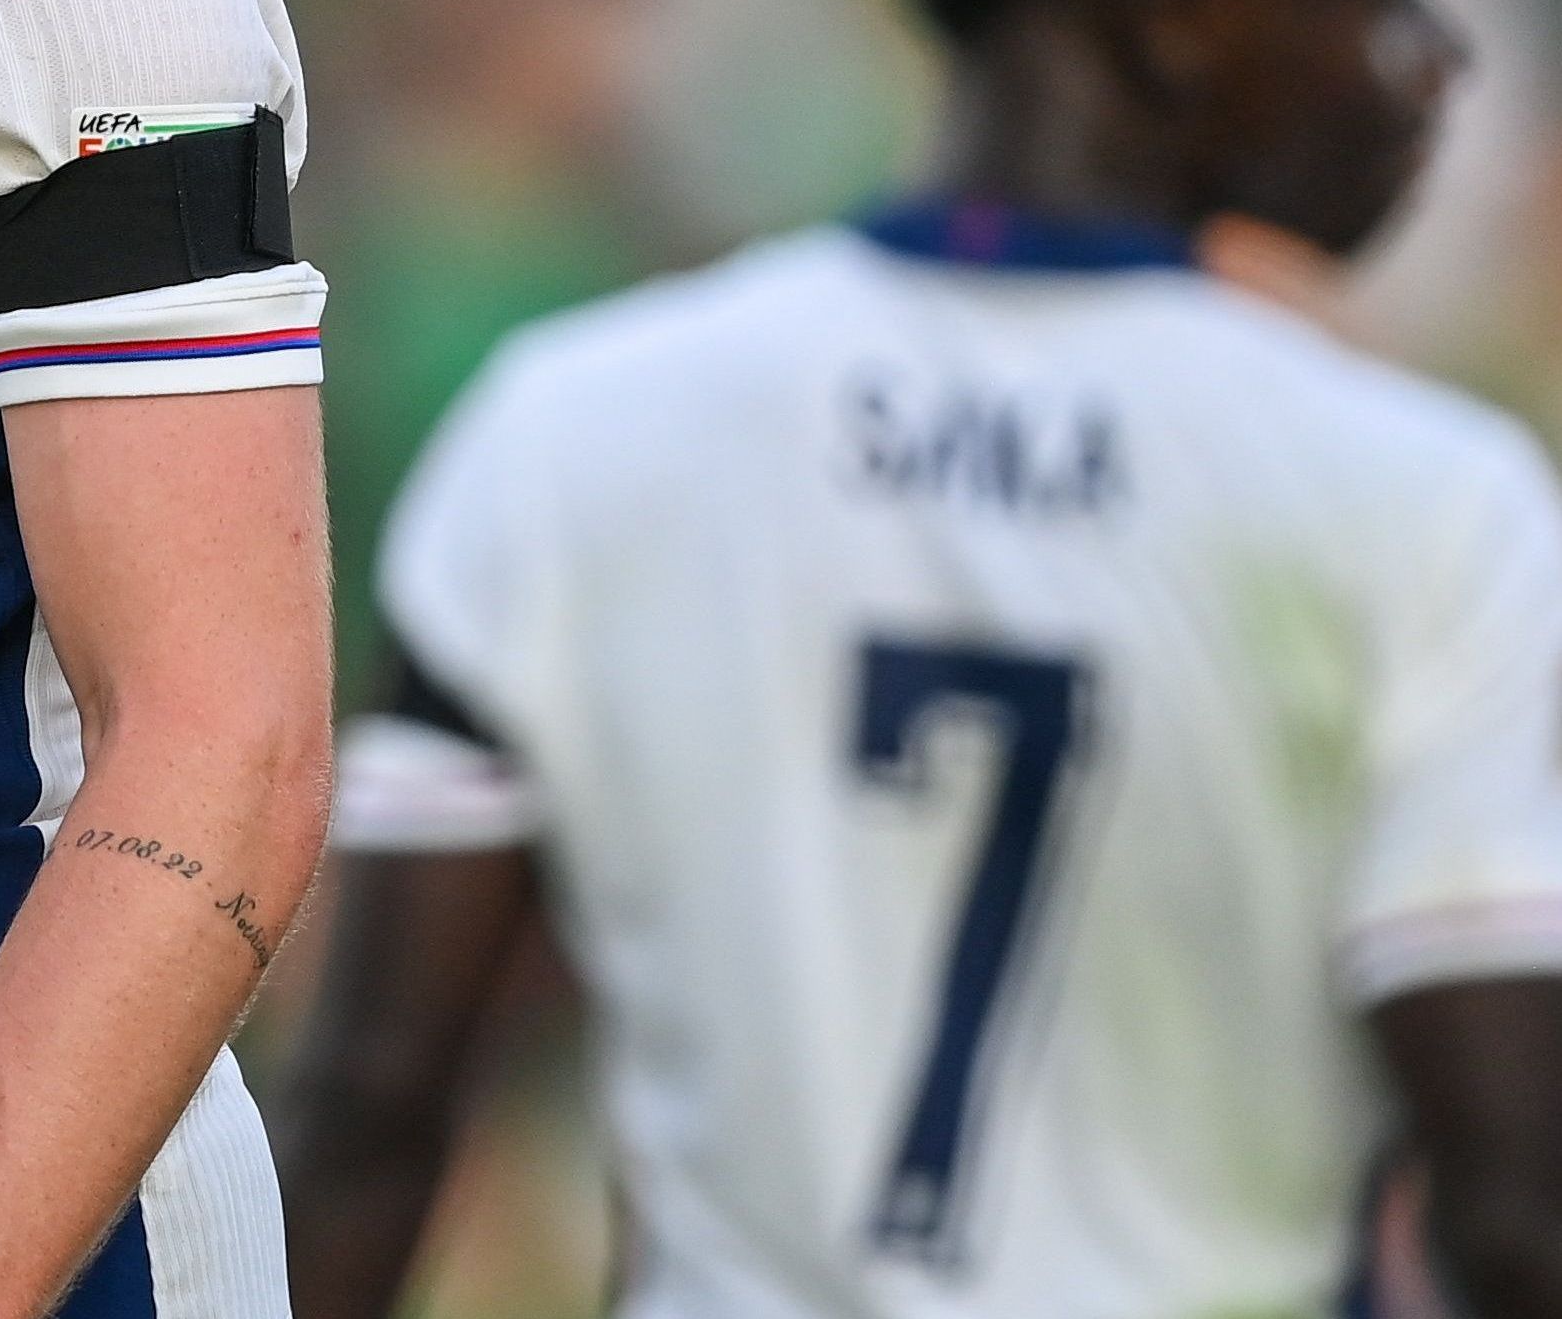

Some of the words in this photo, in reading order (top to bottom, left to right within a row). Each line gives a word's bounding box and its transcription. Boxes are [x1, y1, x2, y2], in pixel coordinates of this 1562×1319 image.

[78, 112, 142, 133] UEFA
[76, 829, 203, 878] 07.08.22
[851, 638, 1098, 1265] 7
